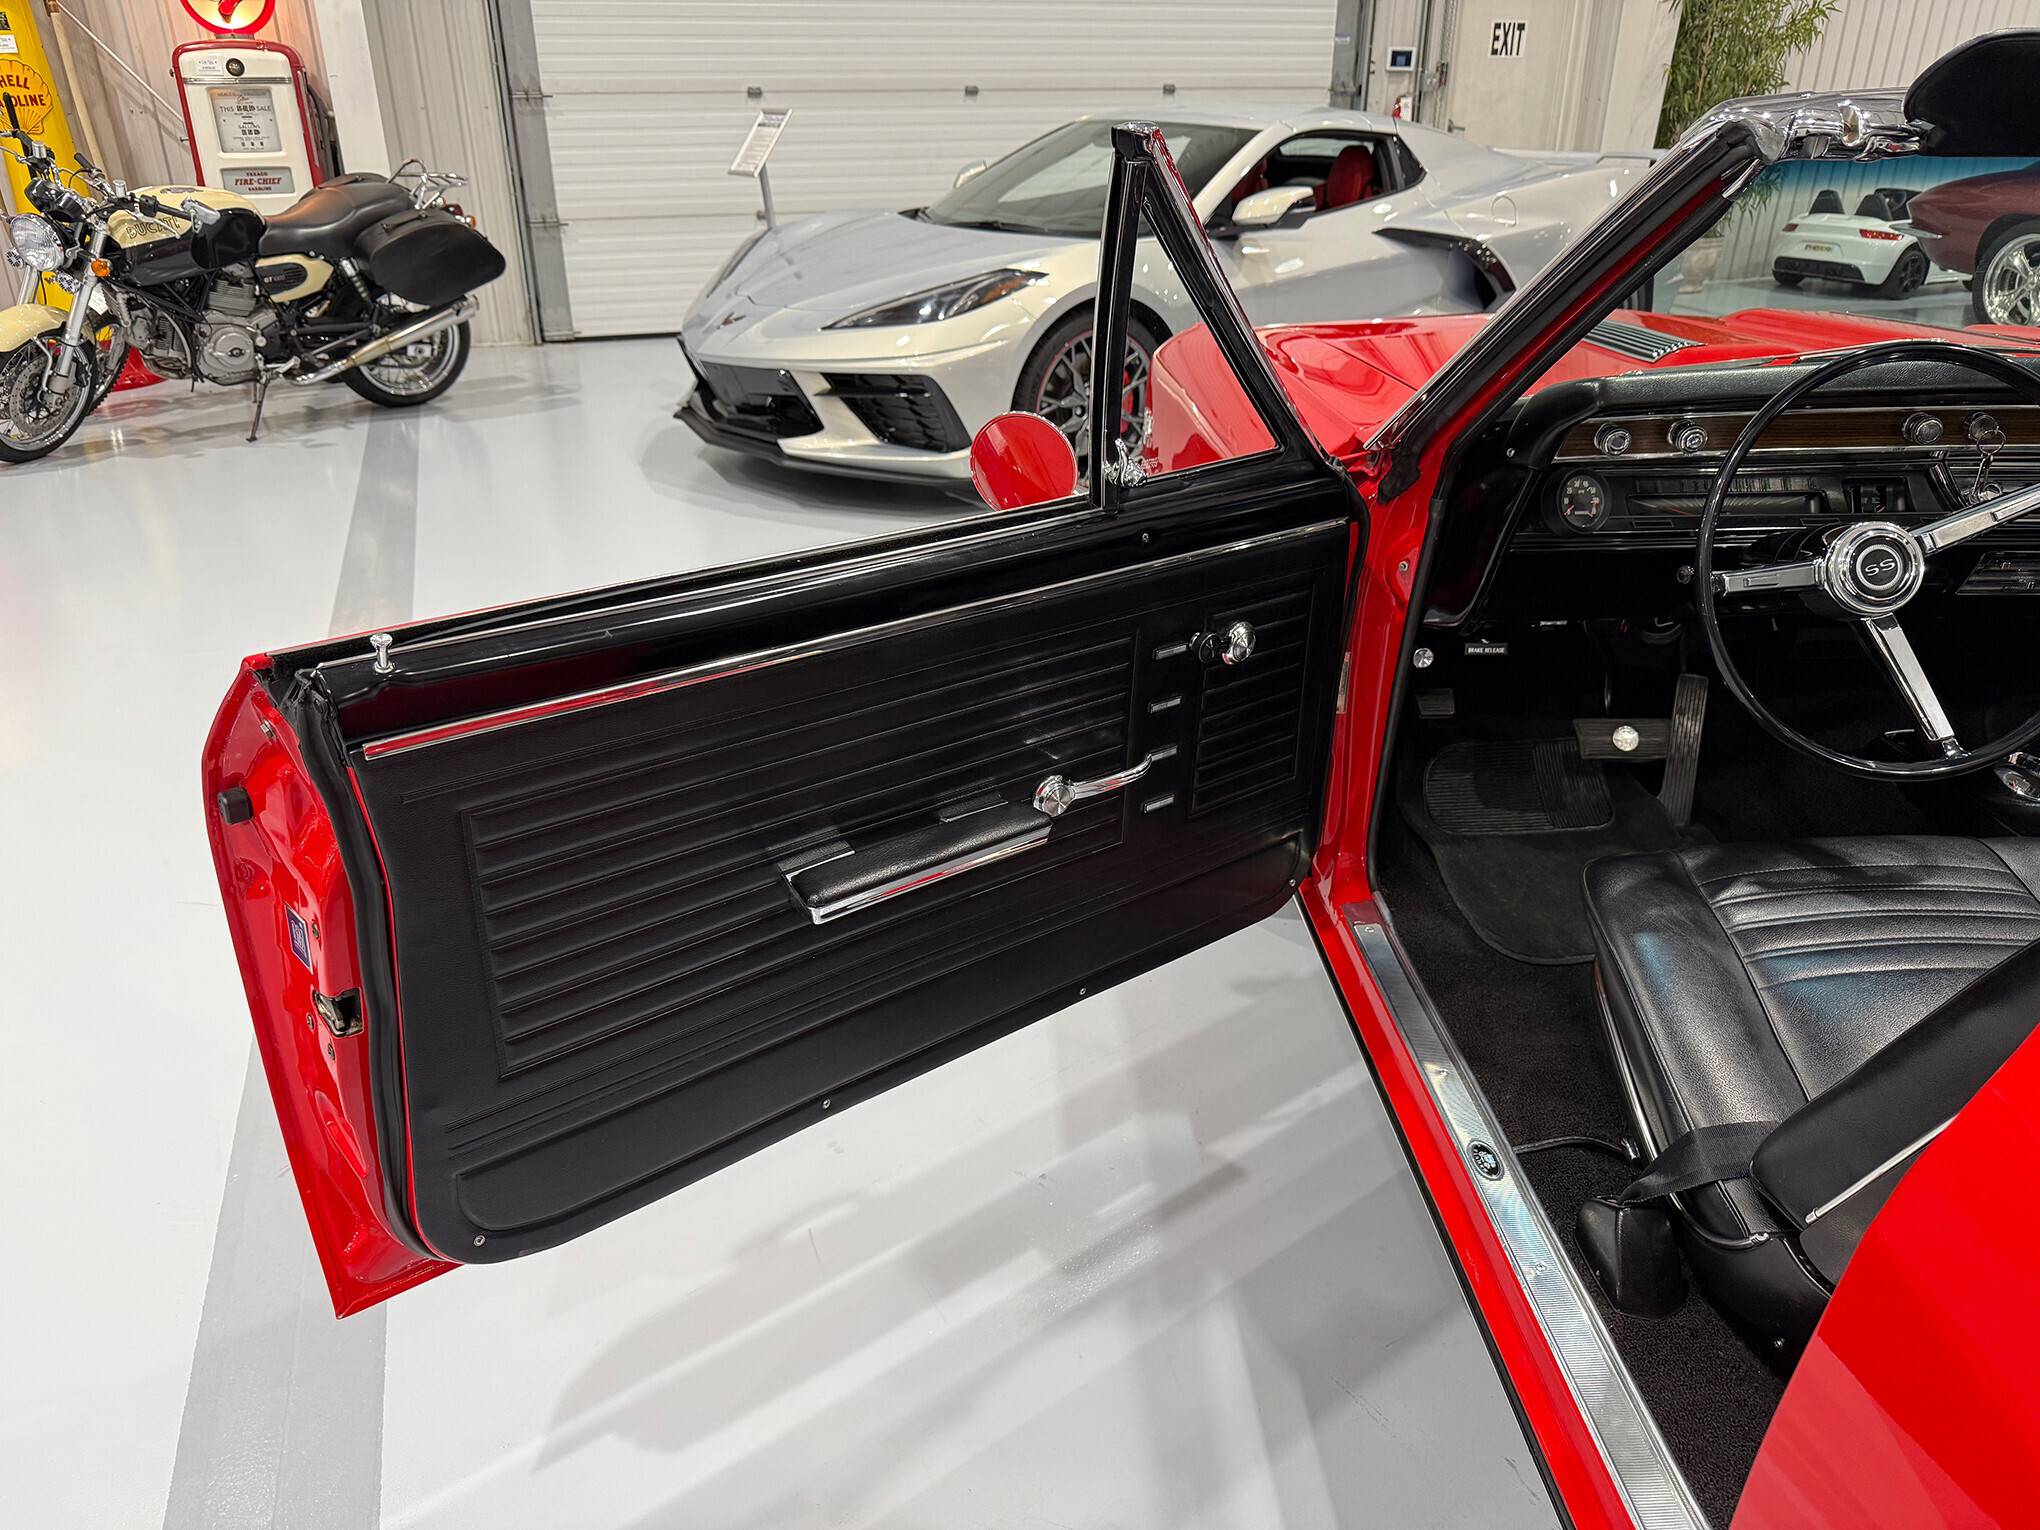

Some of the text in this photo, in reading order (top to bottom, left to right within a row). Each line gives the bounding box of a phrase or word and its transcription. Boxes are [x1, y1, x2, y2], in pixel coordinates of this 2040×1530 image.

[1490, 22, 1526, 56] EXIT
[0, 74, 30, 90] HELL
[1865, 559, 1895, 576] SS
